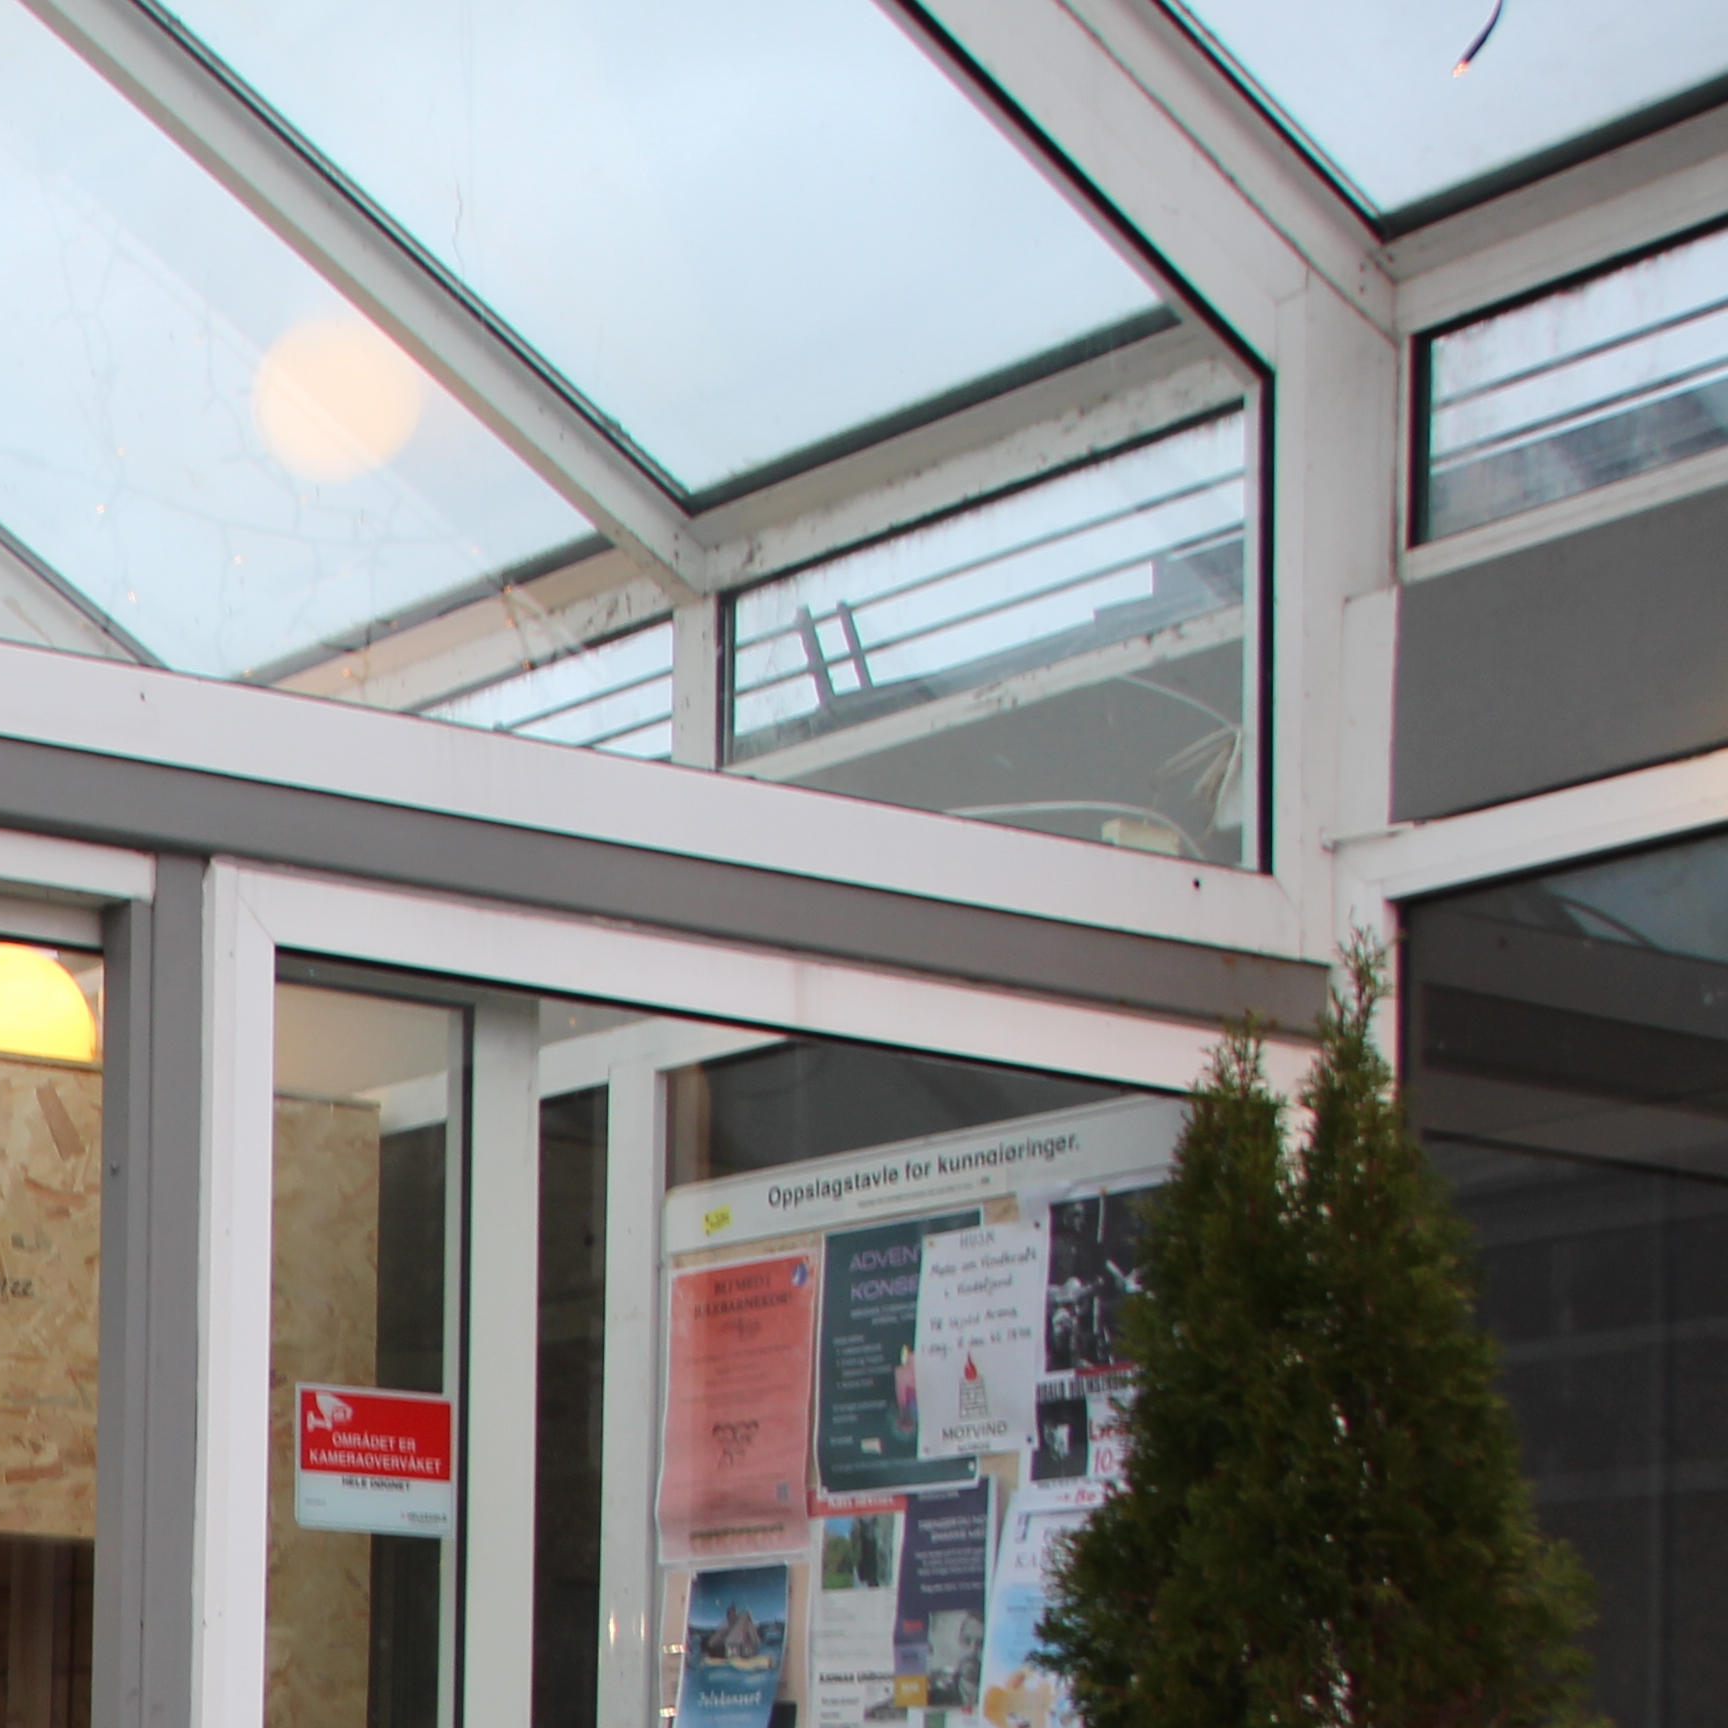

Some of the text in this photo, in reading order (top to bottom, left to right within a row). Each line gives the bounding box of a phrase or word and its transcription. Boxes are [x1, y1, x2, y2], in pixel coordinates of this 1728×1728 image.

[768, 1164, 899, 1211] Oppslagstavle
[905, 1160, 931, 1182] for
[849, 1243, 921, 1272] ADVEN
[332, 1430, 417, 1453] OMRÅDET ER
[309, 1448, 442, 1475] KAMERAOVERVÅKET
